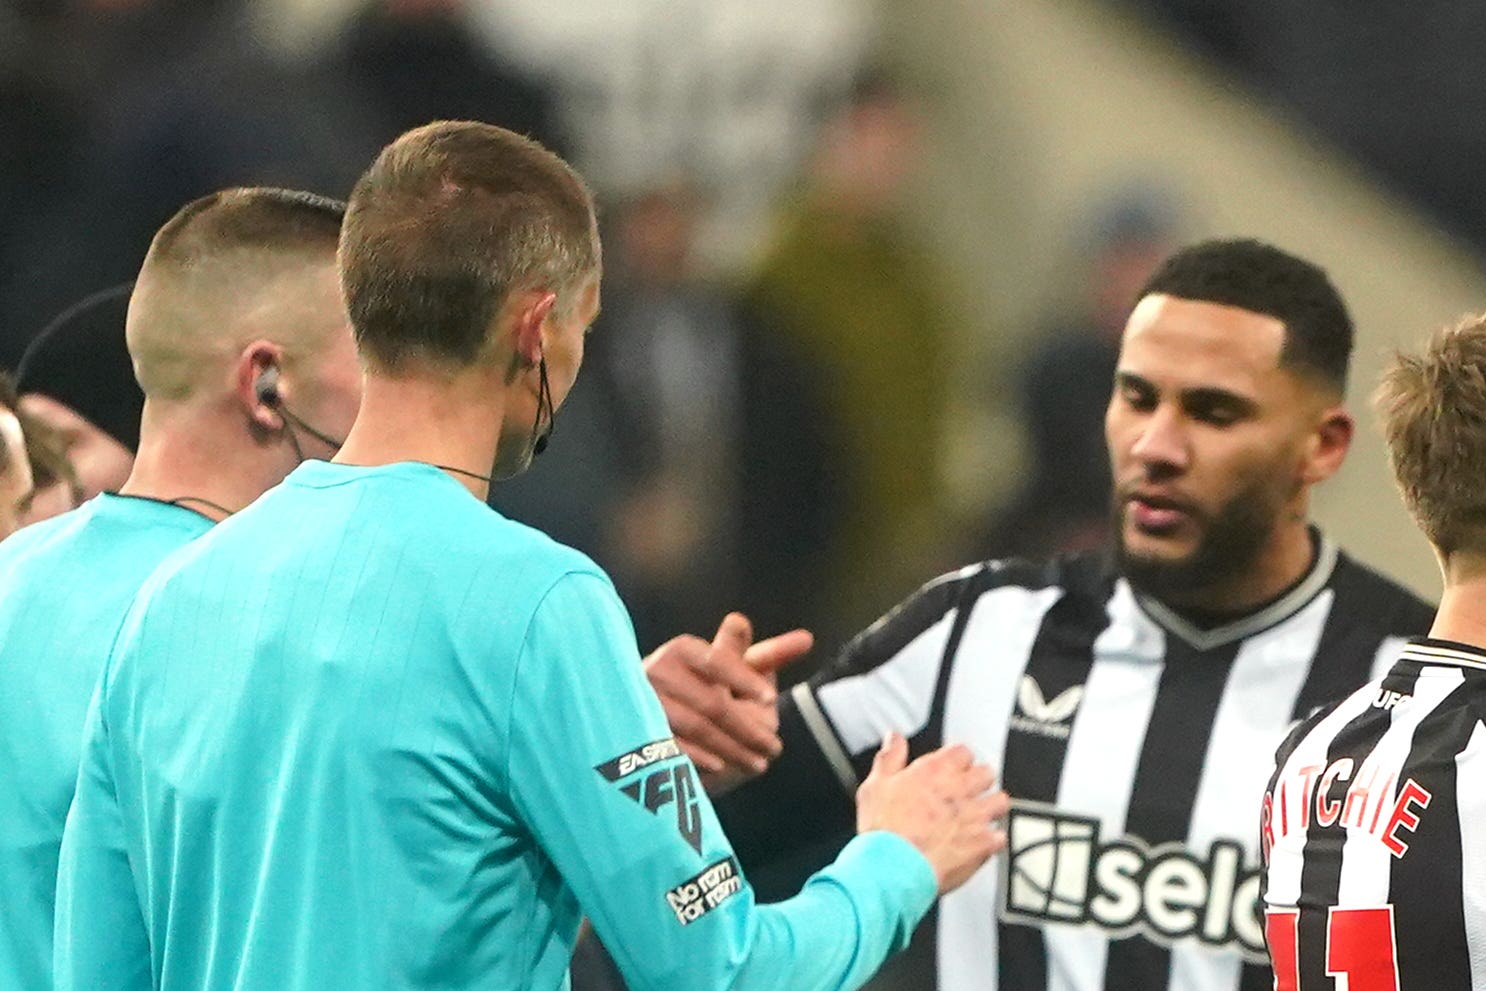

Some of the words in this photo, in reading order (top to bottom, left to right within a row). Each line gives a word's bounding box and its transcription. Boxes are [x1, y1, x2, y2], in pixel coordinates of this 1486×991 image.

[619, 753, 646, 777] EA
[1261, 758, 1432, 867] RITCHIE
[667, 884, 699, 909] No
